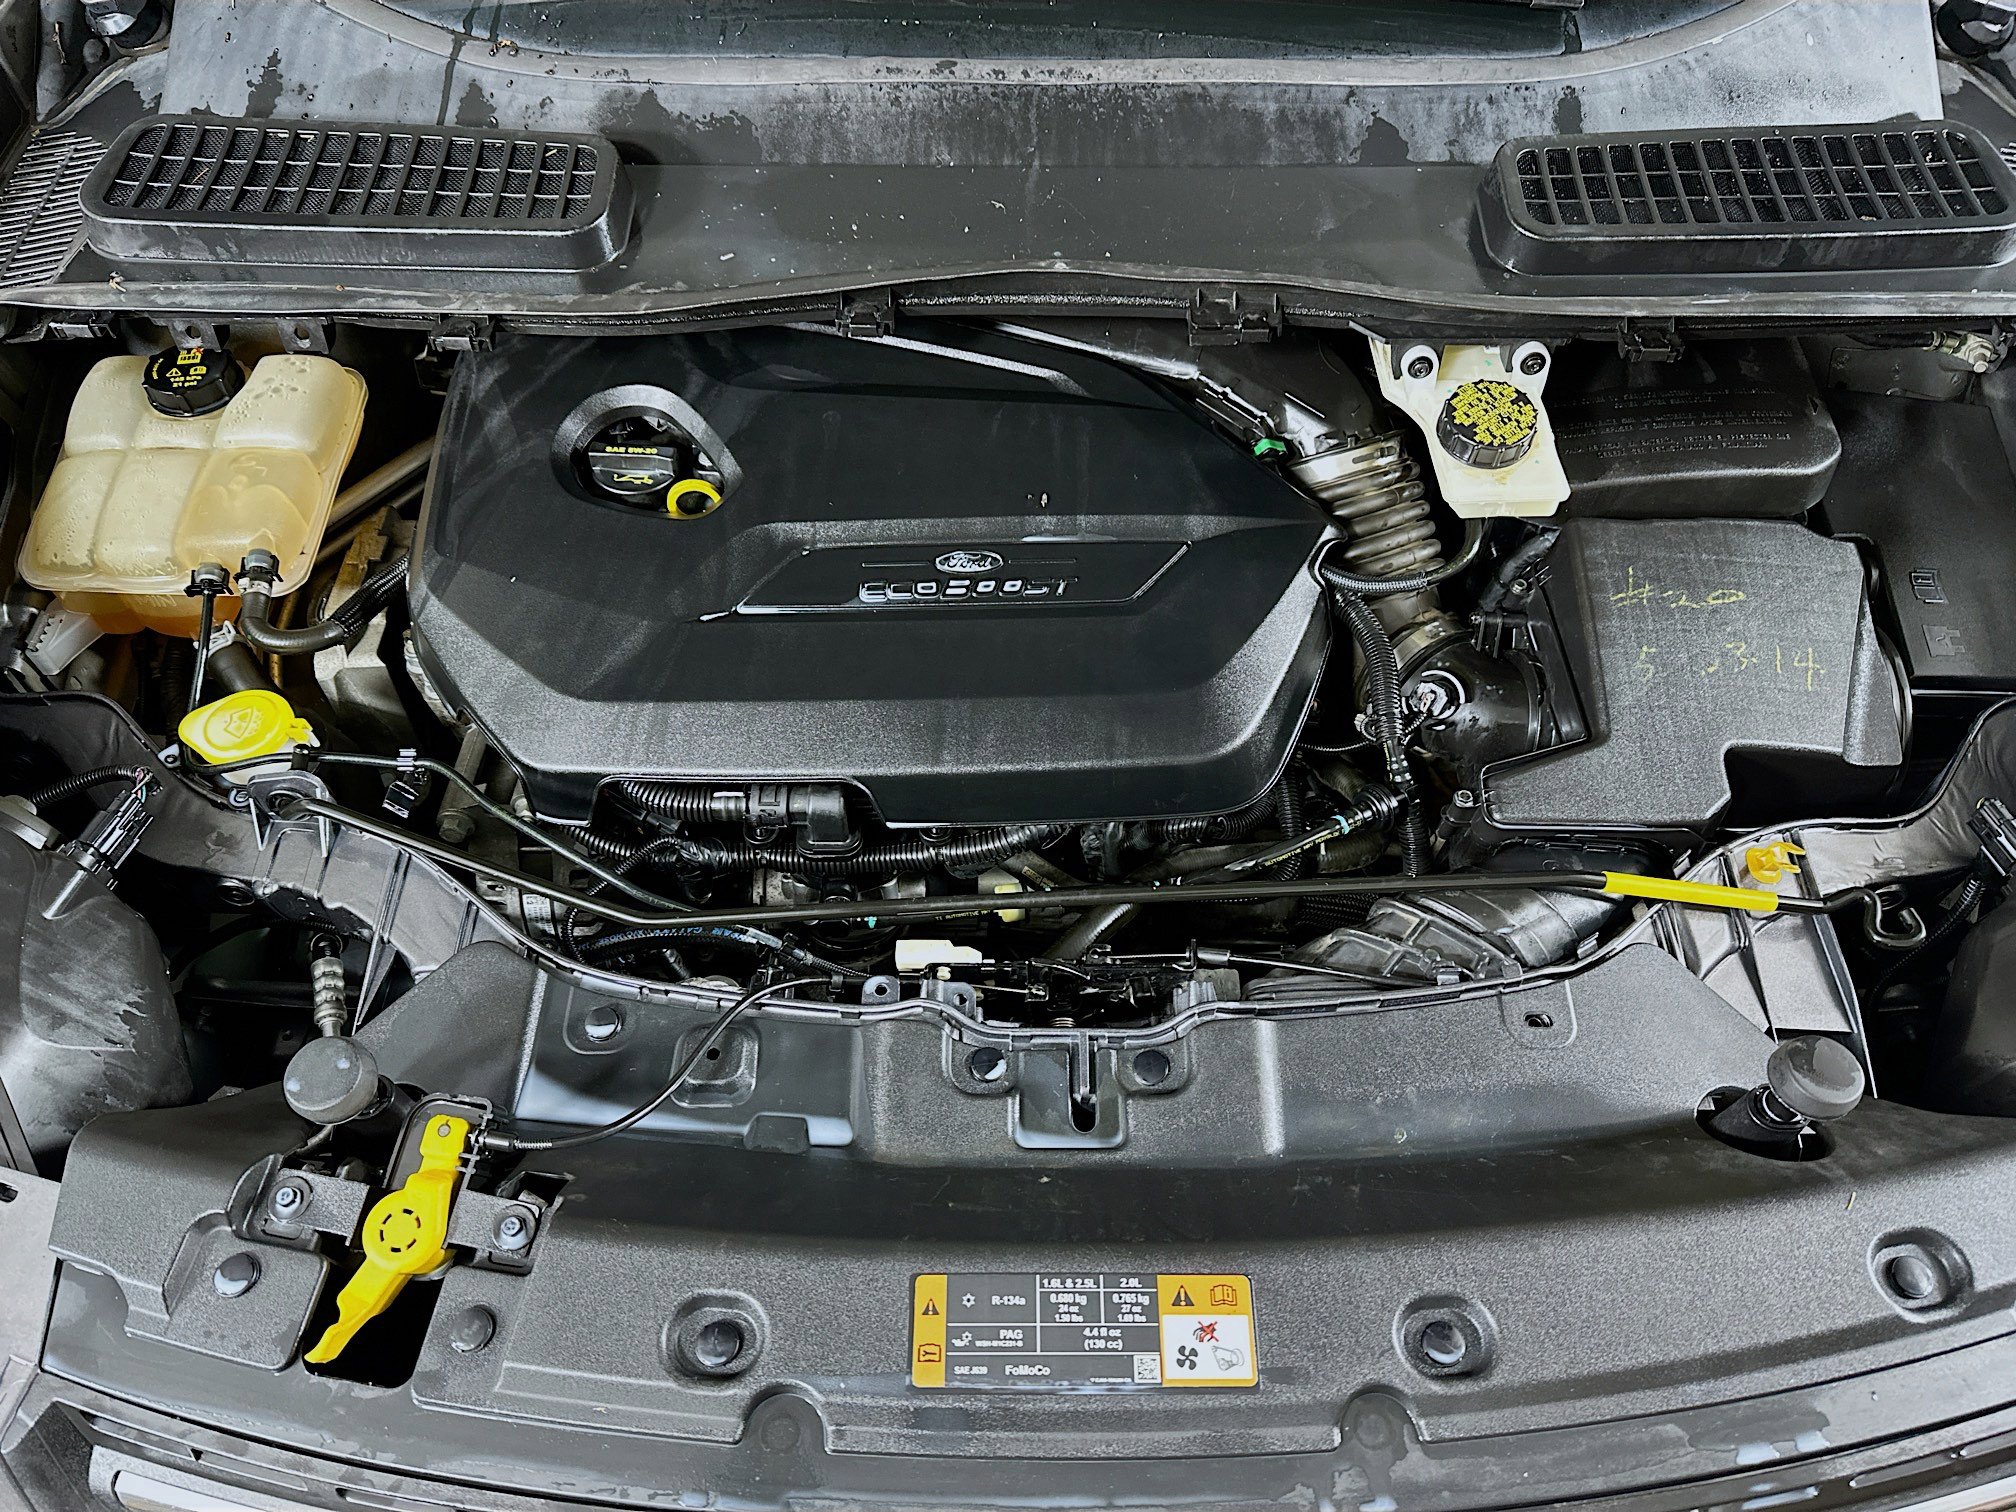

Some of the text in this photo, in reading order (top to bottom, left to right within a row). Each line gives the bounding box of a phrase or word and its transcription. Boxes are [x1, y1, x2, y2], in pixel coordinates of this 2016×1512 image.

[946, 551, 995, 571] Ford
[858, 576, 1078, 602] ECOBOOST
[946, 910, 980, 920] AUTOMOTIVE
[1042, 1278, 1097, 1288] 1.6L & 2.5L
[1120, 1278, 1142, 1288] 2.0L
[991, 1295, 1026, 1305] R-134a
[1075, 1293, 1087, 1305] kg
[1112, 1293, 1150, 1305] 0.765 kg
[1058, 1304, 1068, 1312] 24
[1121, 1304, 1131, 1312] 27
[1071, 1313, 1083, 1322] lbs
[1134, 1313, 1146, 1322] lbs
[1000, 1329, 1023, 1340] PAG
[1083, 1327, 1121, 1337] 4.4 fl oz
[1084, 1339, 1123, 1351] (130 cc)
[954, 1366, 970, 1374] SAE
[1005, 1364, 1051, 1375] FoMoCo
